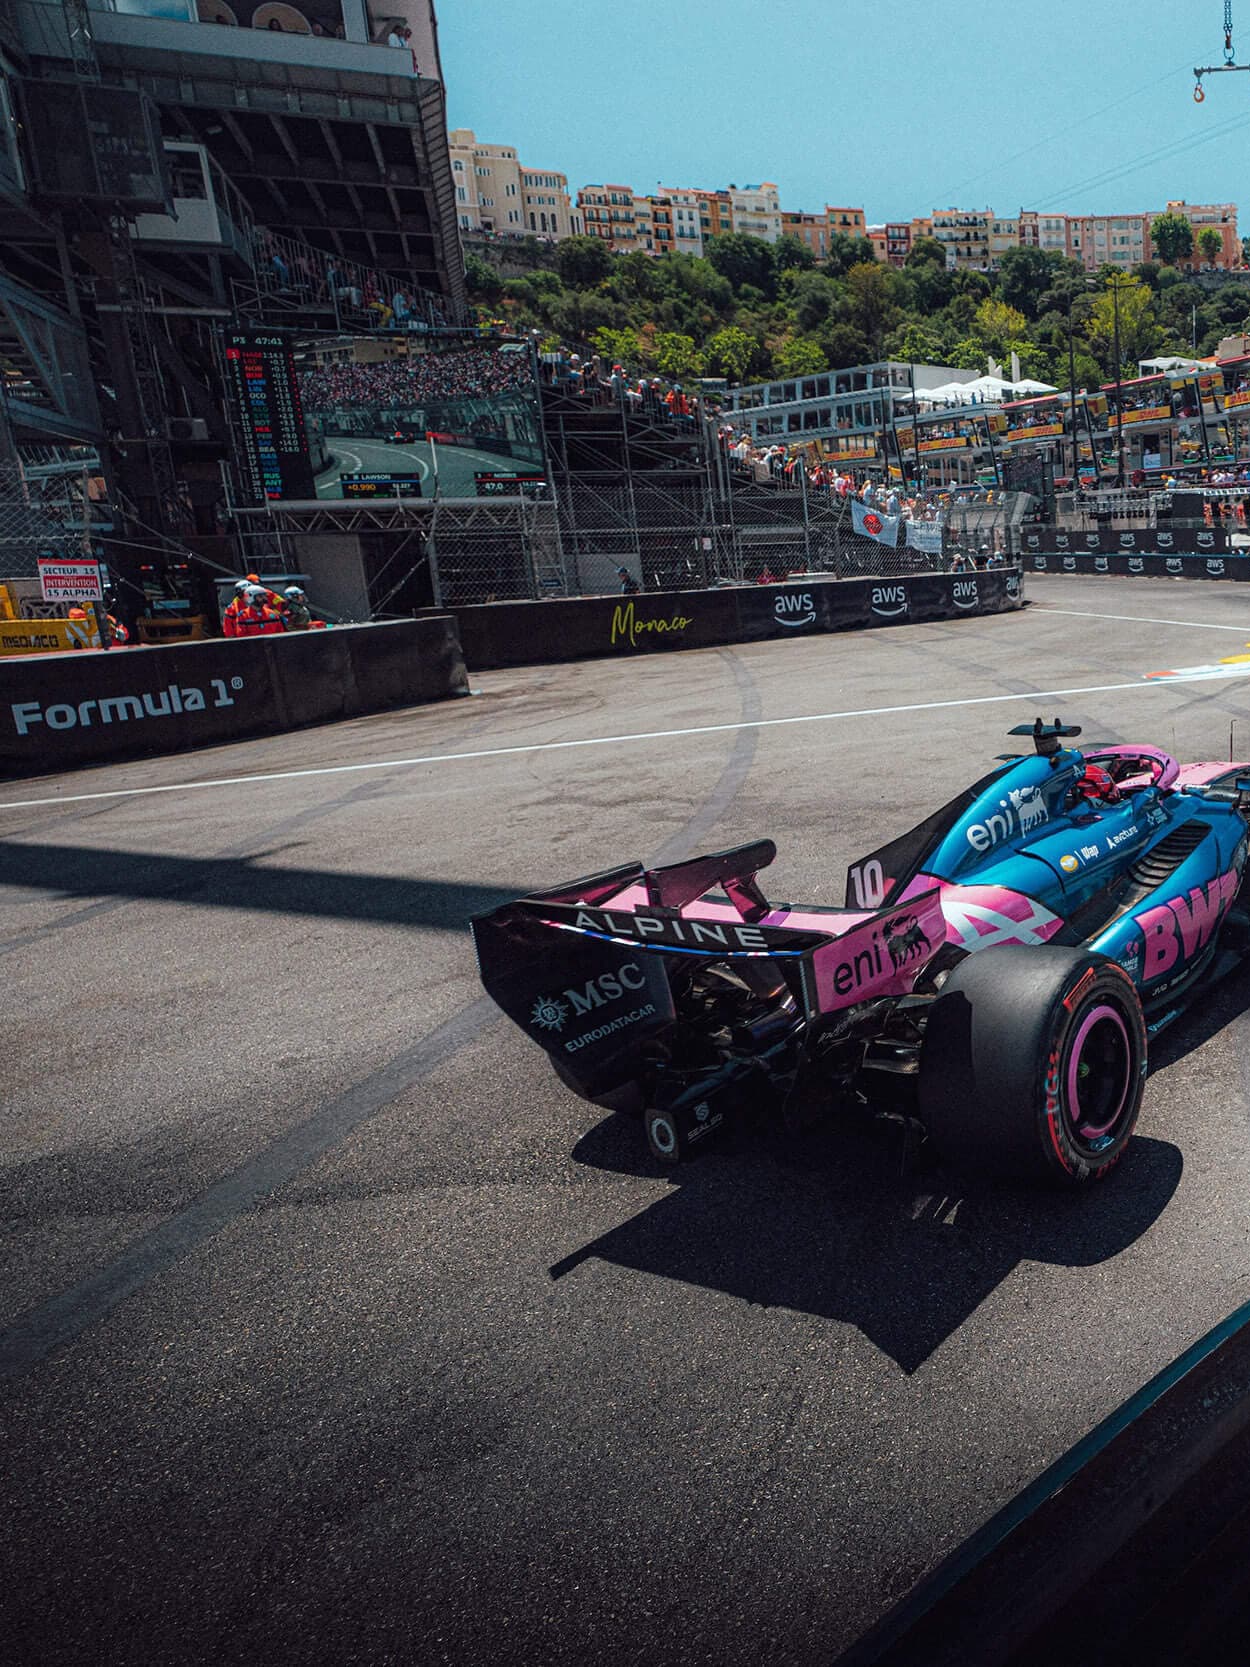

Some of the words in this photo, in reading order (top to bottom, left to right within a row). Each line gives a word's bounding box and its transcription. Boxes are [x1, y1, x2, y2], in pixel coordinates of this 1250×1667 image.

[43, 567, 78, 575] SECTEUR
[46, 579, 97, 587] INTERVENTION
[610, 601, 694, 647] Monaco
[11, 684, 207, 735] Formula
[966, 799, 1014, 851] eni
[1081, 844, 1099, 860] Wap
[850, 859, 885, 909] 10
[575, 911, 769, 949] ALPINE
[562, 962, 646, 1016] MSC
[833, 932, 882, 996] eni
[564, 1003, 656, 1053] EURODATACAR
